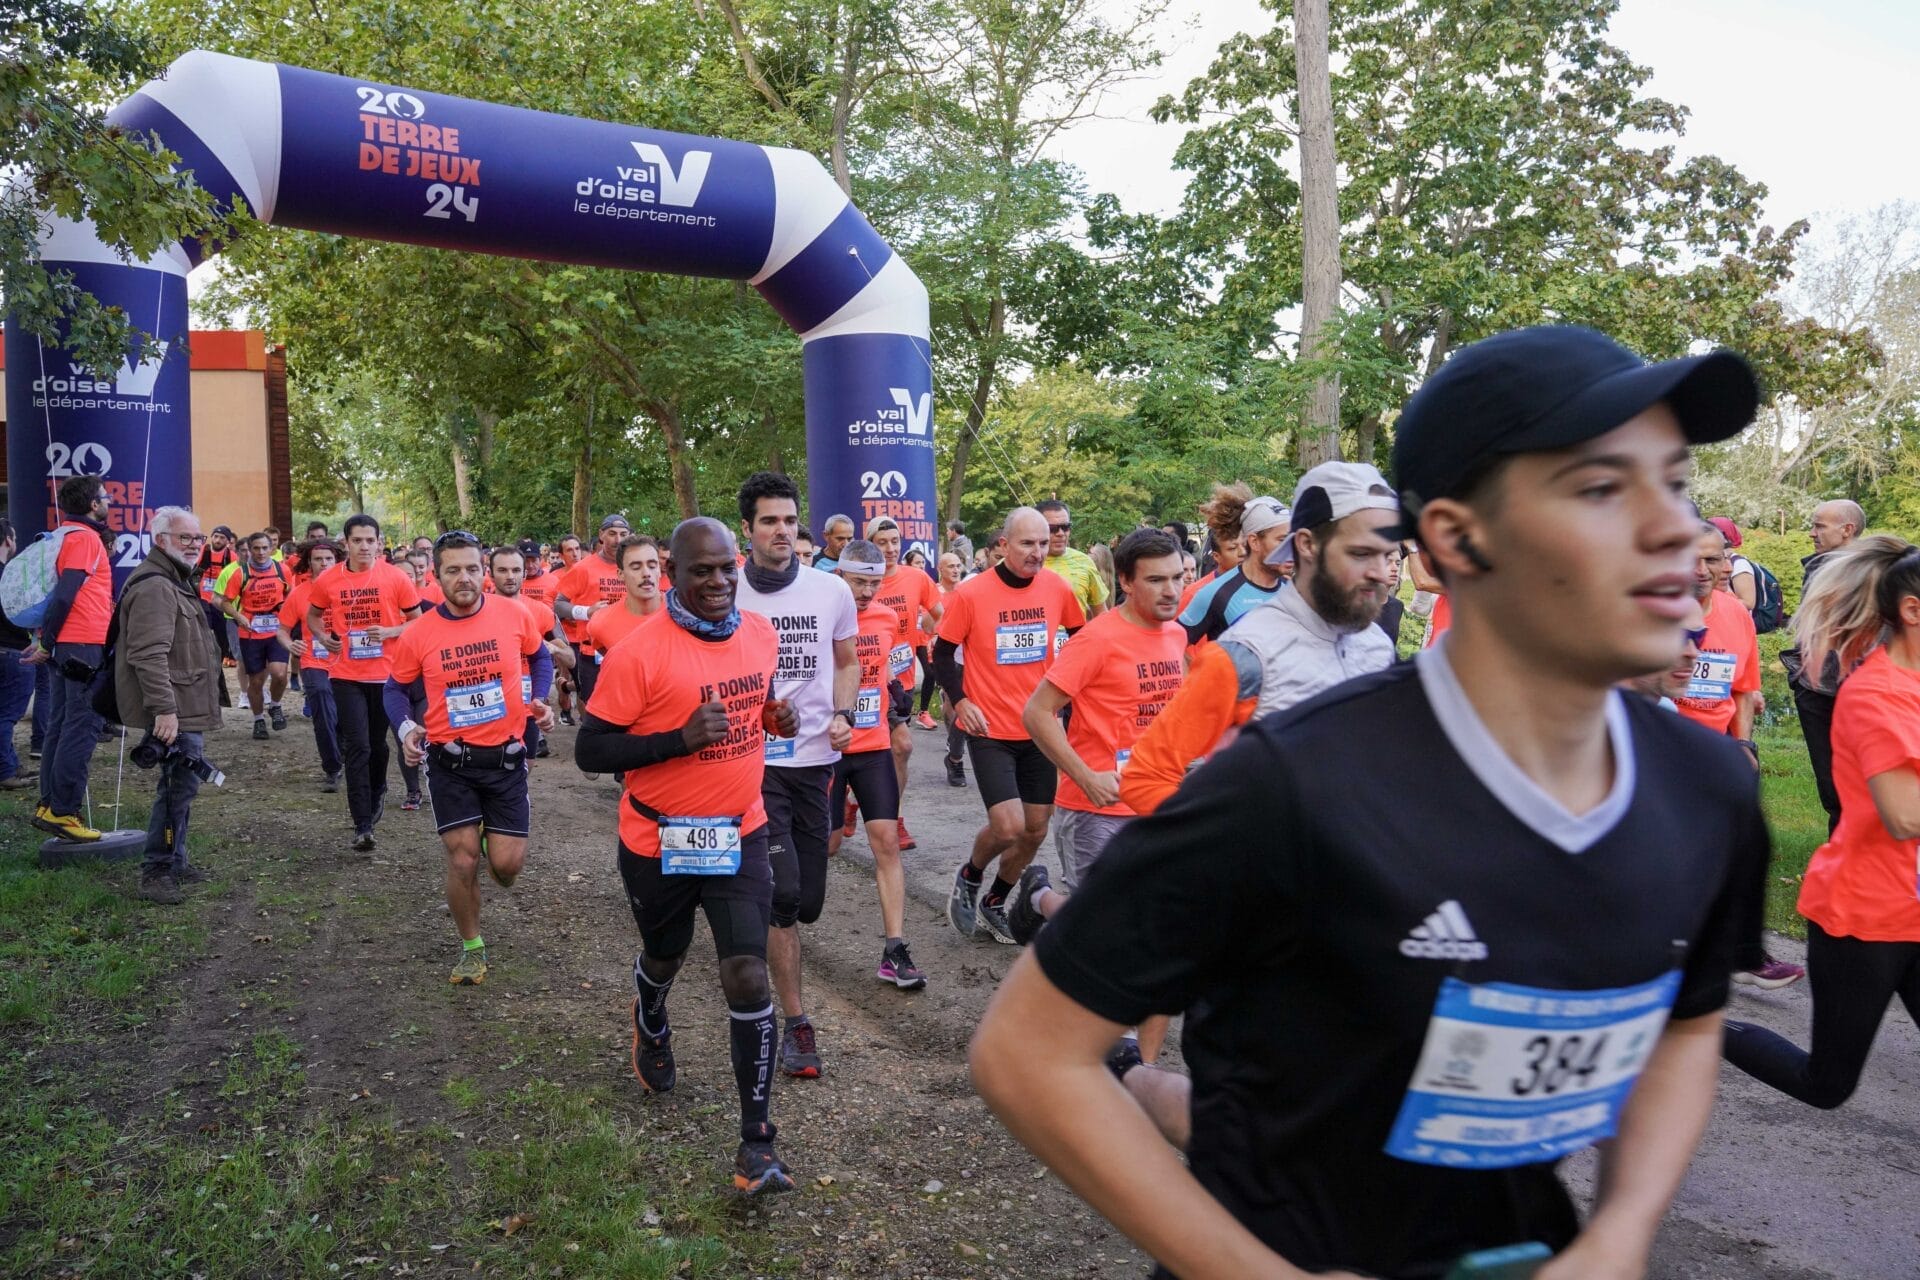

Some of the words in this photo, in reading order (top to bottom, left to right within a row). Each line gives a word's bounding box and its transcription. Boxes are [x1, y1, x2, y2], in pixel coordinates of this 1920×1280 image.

[359, 113, 460, 153] TERRE
[359, 142, 400, 175] DE
[406, 149, 481, 186] JEUX
[616, 166, 656, 184] val
[576, 177, 656, 204] d'oise
[423, 183, 479, 222] 24
[574, 199, 590, 213] le
[593, 202, 717, 228] département
[32, 376, 111, 394] d'oise
[33, 396, 46, 408] le
[49, 395, 171, 413] département
[877, 407, 905, 420] val
[848, 420, 905, 434] d'oise
[848, 436, 860, 446] le
[861, 500, 925, 520] TERRE
[771, 615, 818, 631] DONNE
[998, 610, 1008, 623] JE
[1011, 607, 1046, 622] DONNE
[360, 637, 371, 647] 42
[780, 633, 818, 644] SOUFFLE
[1014, 633, 1034, 648] 356
[440, 648, 452, 661] JE
[454, 639, 498, 659] DONNE
[794, 646, 803, 655] LA
[442, 660, 462, 672] MON
[464, 652, 500, 668] SOUFFLE
[776, 656, 800, 670] ADE
[803, 655, 817, 669] DE
[869, 665, 879, 676] DE
[1136, 663, 1148, 679] JE
[458, 670, 478, 679] POUR
[479, 666, 487, 674] LA
[700, 684, 713, 704] JE
[718, 672, 764, 700] DONNE
[1139, 682, 1157, 694] MON
[469, 693, 485, 708] 48
[727, 693, 764, 714] SOUFFLE
[686, 828, 718, 850] 498
[752, 1019, 775, 1101] kalenji
[1511, 1032, 1612, 1096] 384
